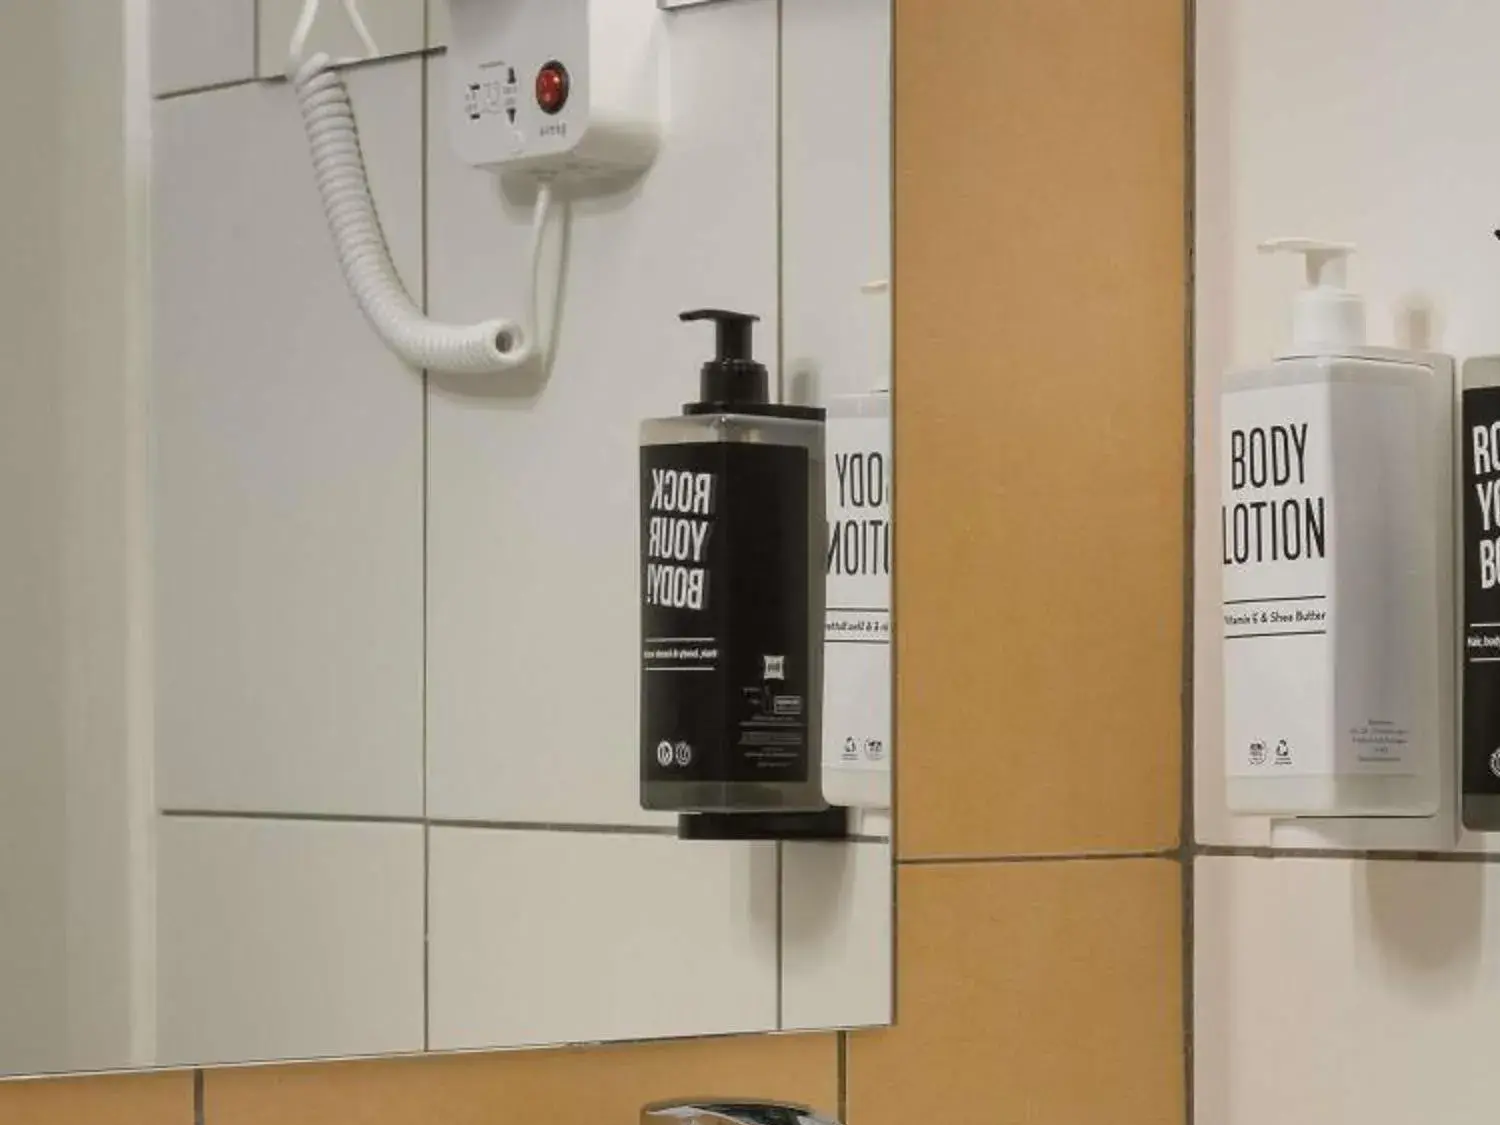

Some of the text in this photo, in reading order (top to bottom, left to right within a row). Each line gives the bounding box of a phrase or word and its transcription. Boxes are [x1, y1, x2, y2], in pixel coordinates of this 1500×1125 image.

[1231, 423, 1308, 490] BODY
[1222, 496, 1325, 565] LOTION
[1269, 611, 1293, 623] Shea
[1295, 610, 1327, 622] Butter
